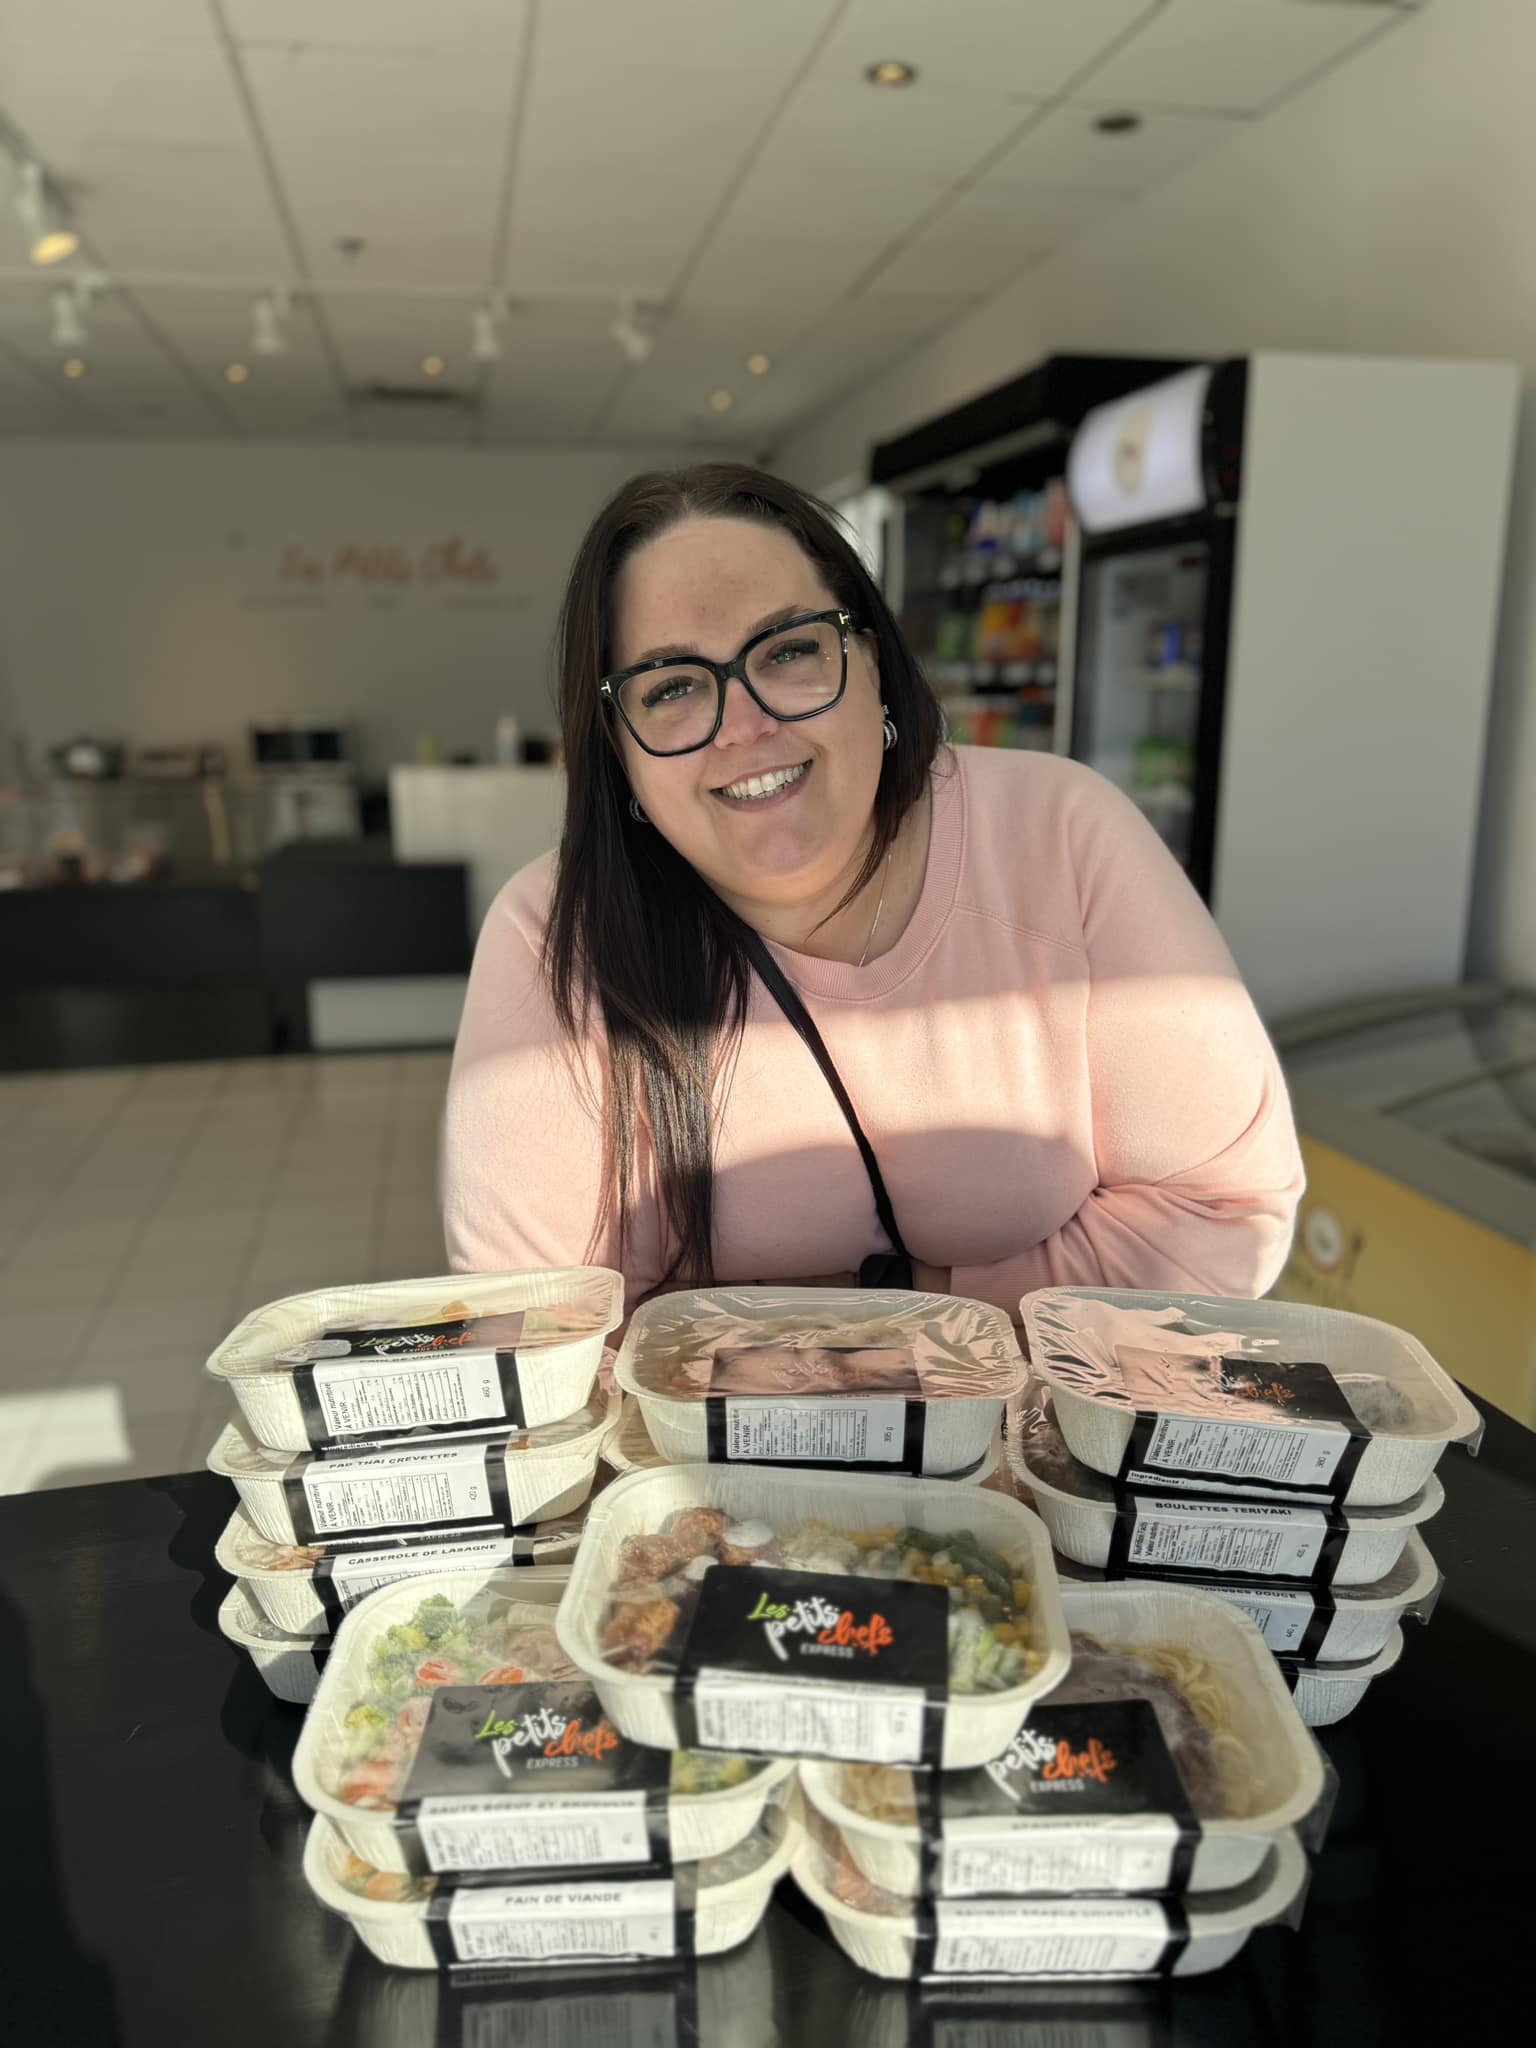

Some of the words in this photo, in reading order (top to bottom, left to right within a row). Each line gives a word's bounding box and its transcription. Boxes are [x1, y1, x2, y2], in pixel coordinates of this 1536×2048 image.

[731, 1429, 740, 1454] Valeur
[743, 1424, 751, 1446] VENIR
[389, 1452, 458, 1464] CREVETTES
[1156, 1502, 1229, 1513] BOULETTES
[1232, 1506, 1292, 1516] TERIYAKI
[348, 1552, 420, 1565] CASSEROLE
[422, 1549, 438, 1557] DE
[441, 1543, 498, 1555] LASAGNE
[747, 1592, 790, 1620] Les
[764, 1596, 841, 1661] petits
[816, 1611, 894, 1656] chefs
[799, 1642, 854, 1659] EXPRESS
[475, 1709, 519, 1739] Les
[492, 1708, 568, 1778] petits
[543, 1719, 620, 1761] chefs
[526, 1757, 580, 1769] EXPRESS
[984, 1729, 1057, 1801] petits
[1041, 1738, 1117, 1784] chefs
[1030, 1779, 1086, 1794] EXPRESS
[505, 1895, 539, 1905] PAIN
[543, 1894, 562, 1904] DE
[568, 1892, 622, 1903] VIANDE
